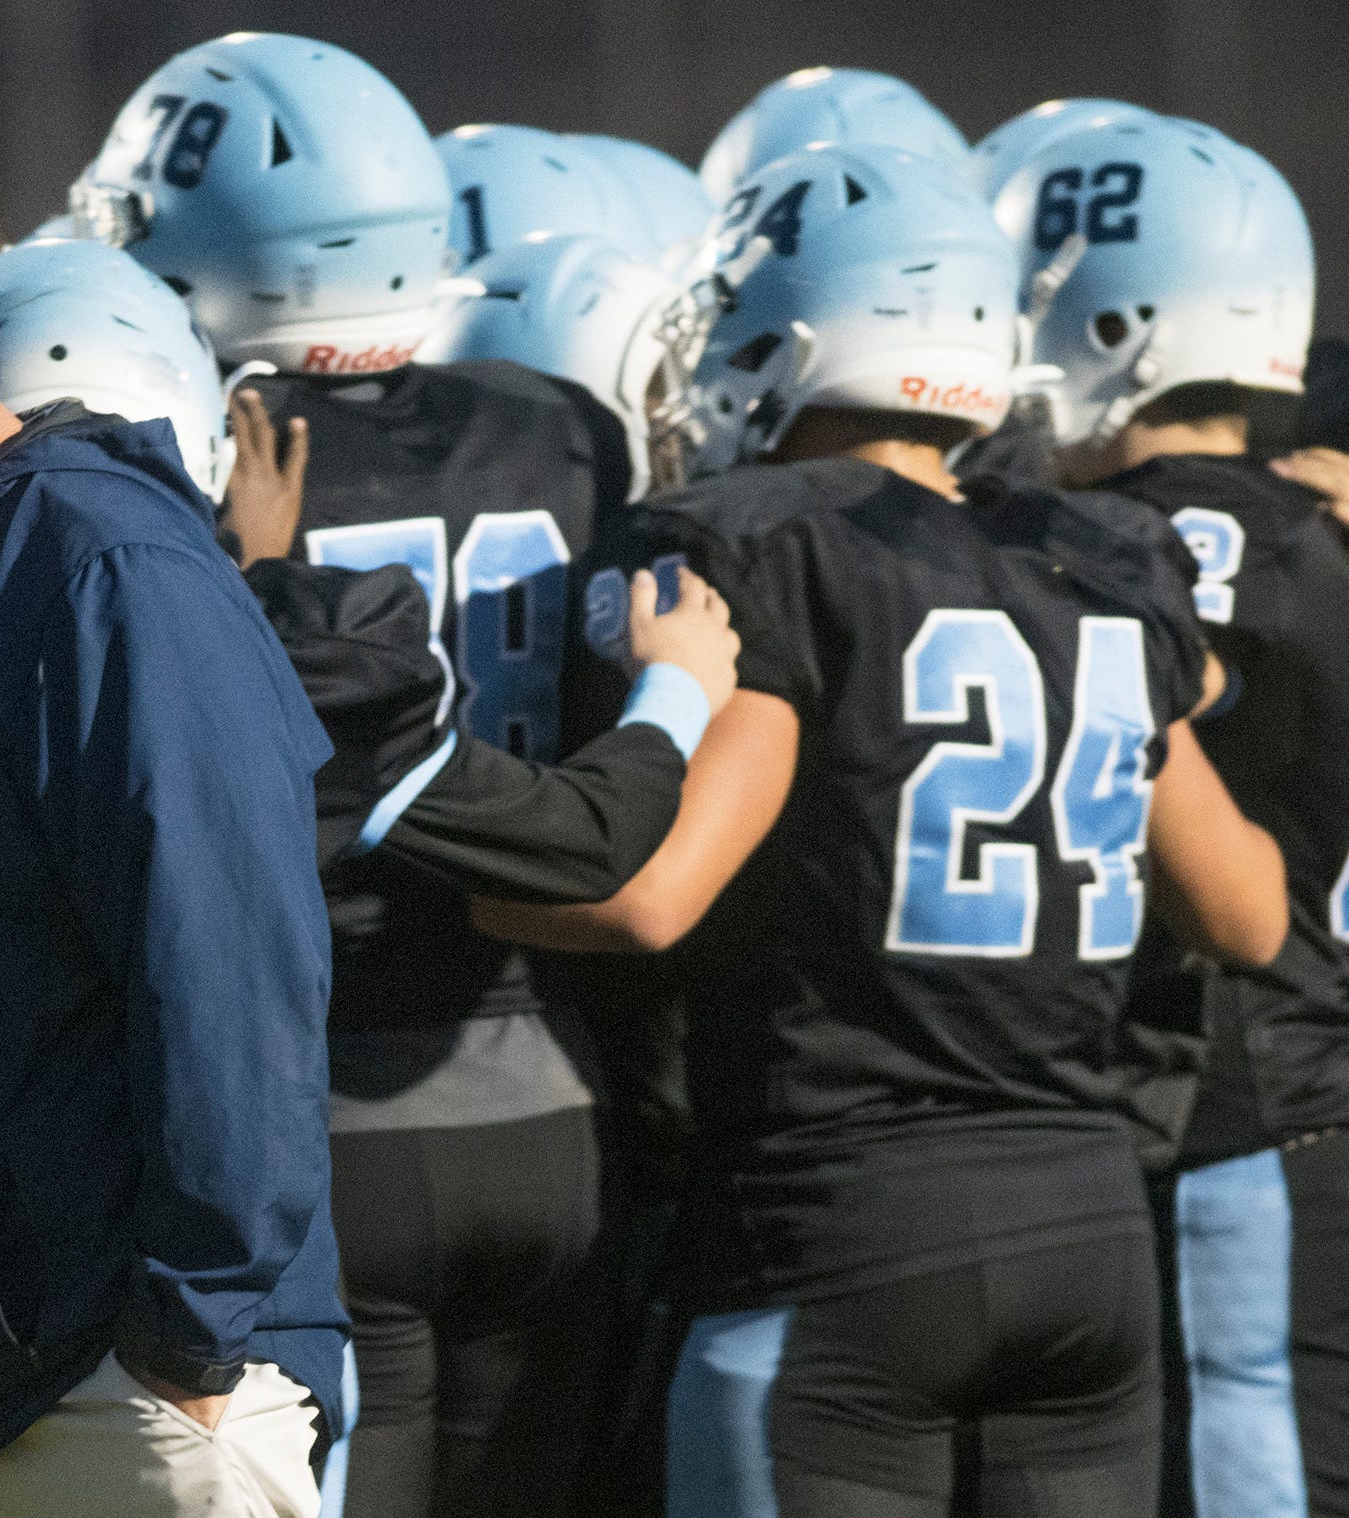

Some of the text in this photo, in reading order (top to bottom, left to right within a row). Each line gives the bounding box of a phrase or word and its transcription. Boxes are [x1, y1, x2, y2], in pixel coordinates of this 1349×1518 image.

[131, 94, 230, 190] 78
[716, 179, 814, 262] 24
[1033, 161, 1144, 252] 62
[301, 344, 426, 373] Ridd
[884, 608, 1154, 960] 24
